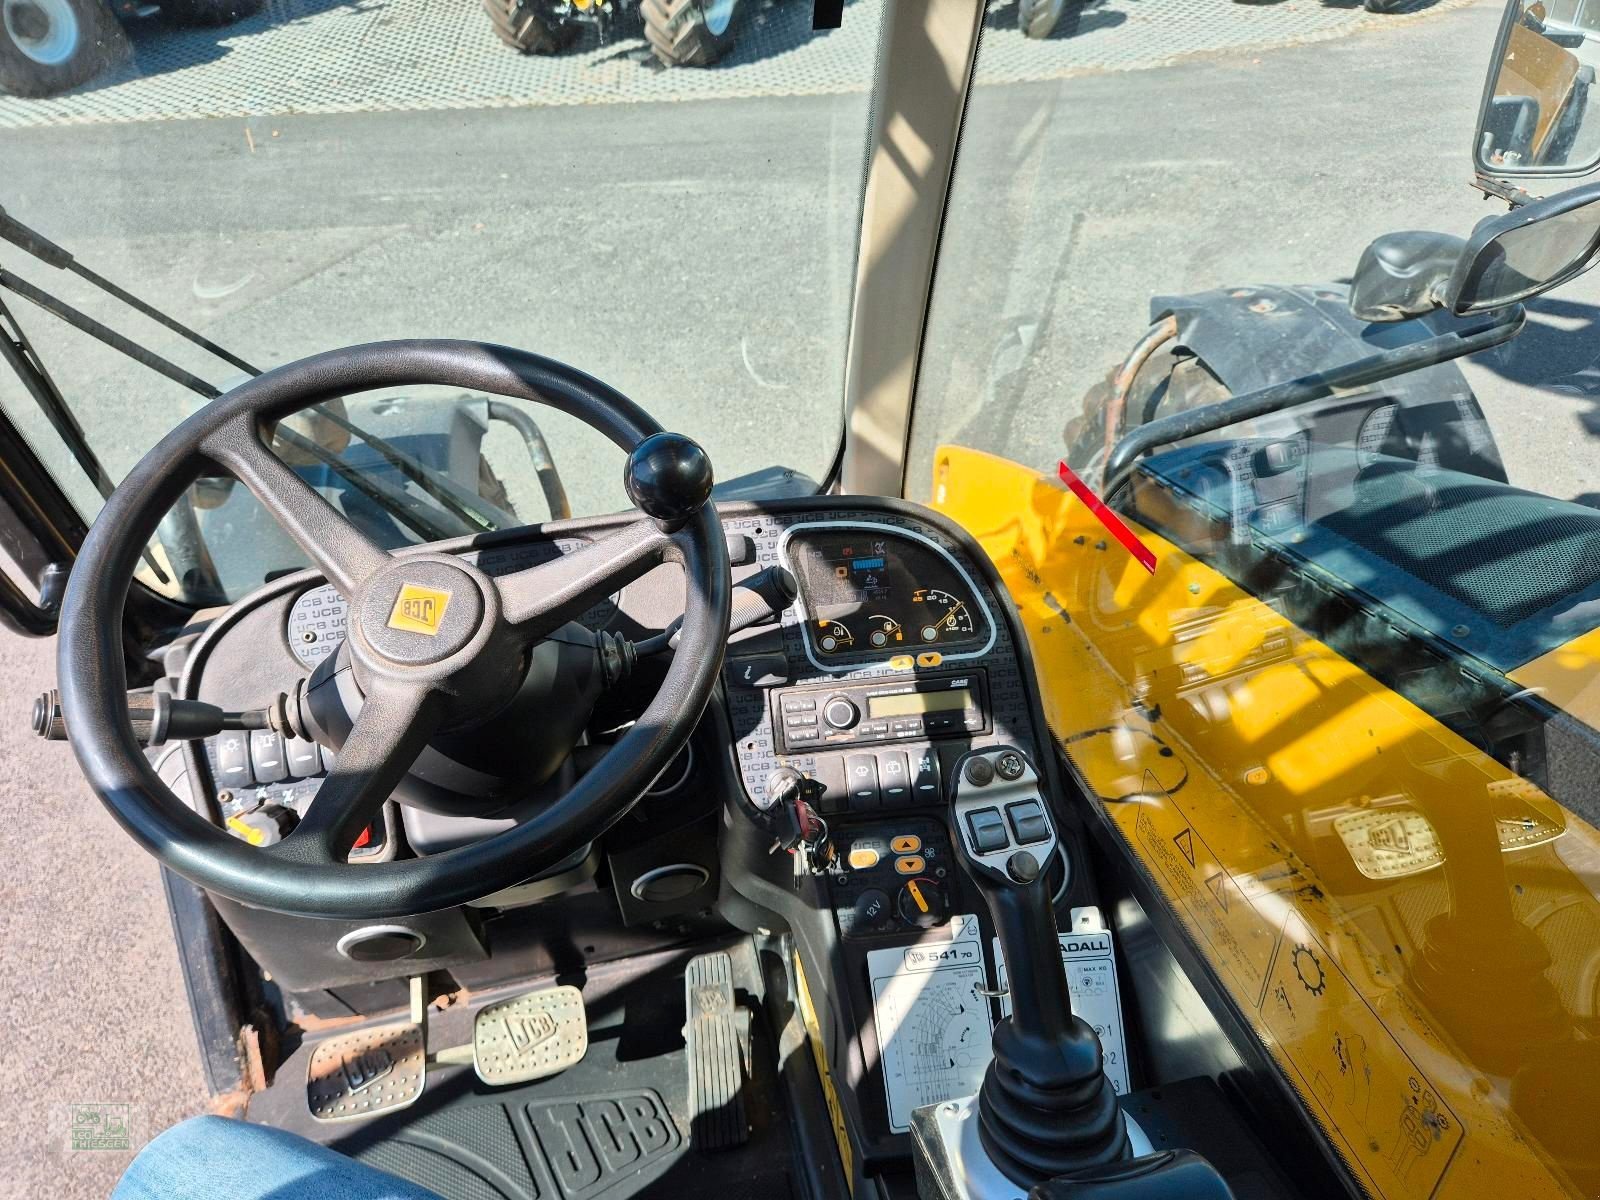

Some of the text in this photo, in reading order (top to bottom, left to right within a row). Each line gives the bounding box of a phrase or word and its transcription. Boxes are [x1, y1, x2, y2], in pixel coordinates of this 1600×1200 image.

[312, 606, 342, 618] JCB
[403, 599, 433, 622] JCB
[866, 899, 881, 917] 12V
[929, 949, 958, 961] 541
[961, 951, 973, 959] 70
[506, 1016, 552, 1048] JCB
[1106, 1023, 1112, 1037] 1
[1109, 1051, 1118, 1065] 2
[547, 1097, 671, 1192] JCB
